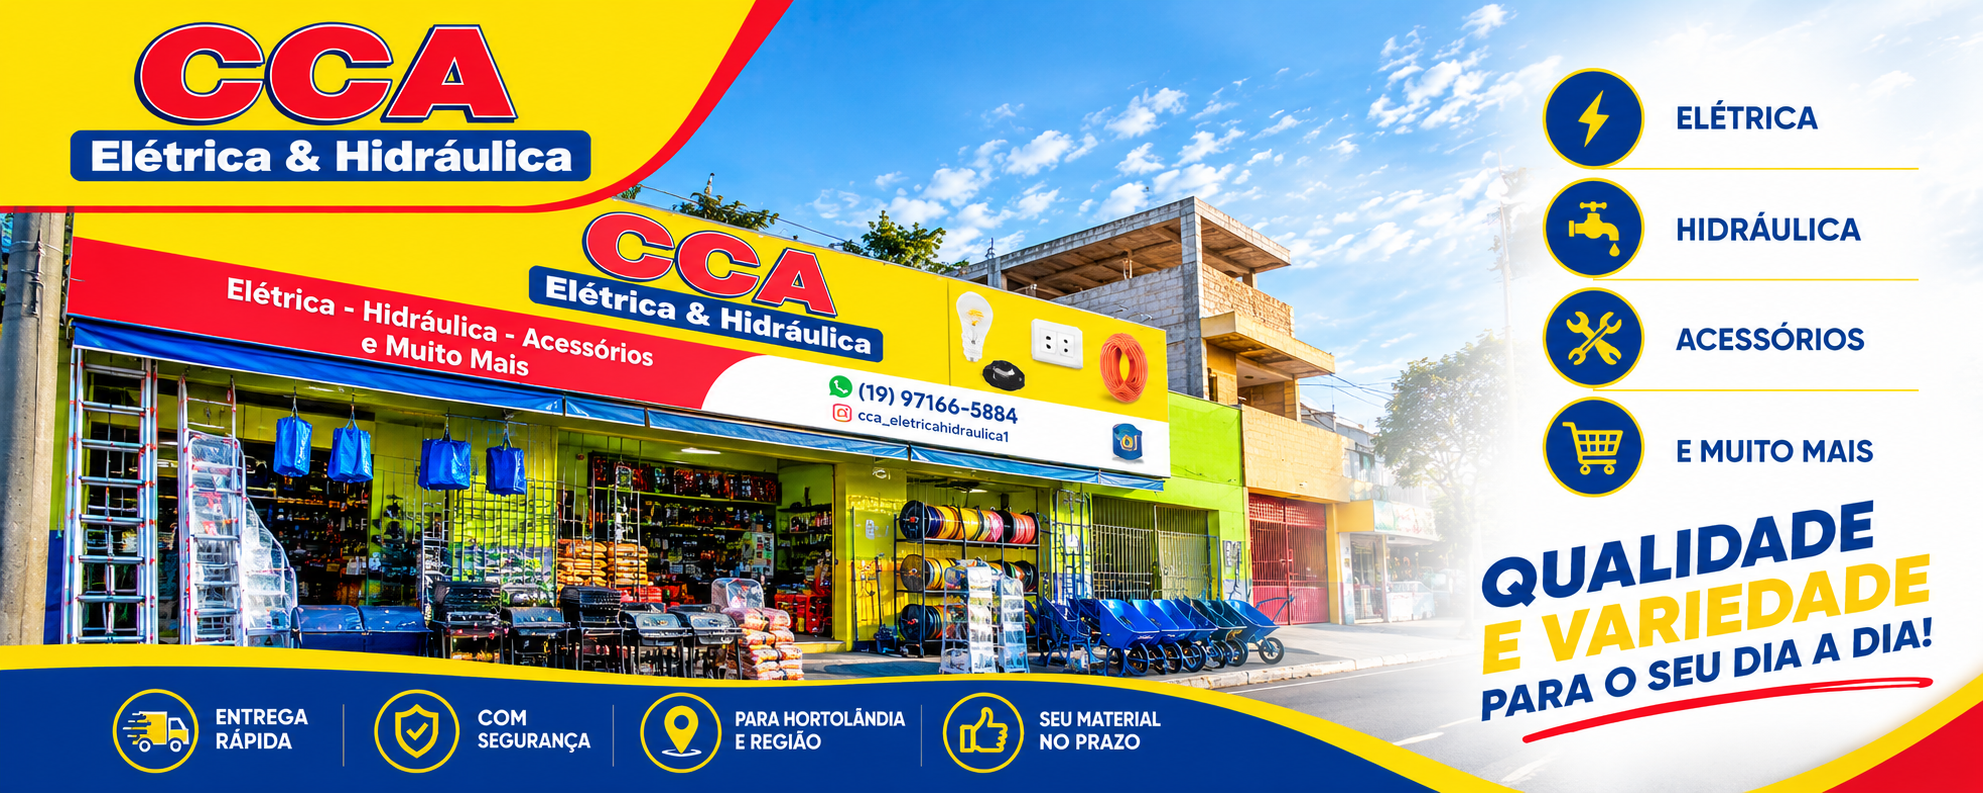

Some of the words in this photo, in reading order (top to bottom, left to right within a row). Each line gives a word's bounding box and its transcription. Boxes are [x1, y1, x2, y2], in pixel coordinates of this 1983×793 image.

[582, 211, 837, 318] CCA
[227, 277, 335, 316] Elétrica
[363, 300, 497, 343] Hidráulica
[522, 328, 654, 367] Acessórios
[546, 275, 676, 320] Elétrica
[686, 302, 710, 327] &
[721, 308, 871, 354] Hidráulica
[361, 337, 378, 354] e
[386, 335, 462, 366] Muito
[470, 348, 529, 377] Mais
[858, 382, 895, 406] (19)
[900, 390, 1018, 424] 97166-5884
[858, 411, 1009, 443] cca_eletricahidraulica1
